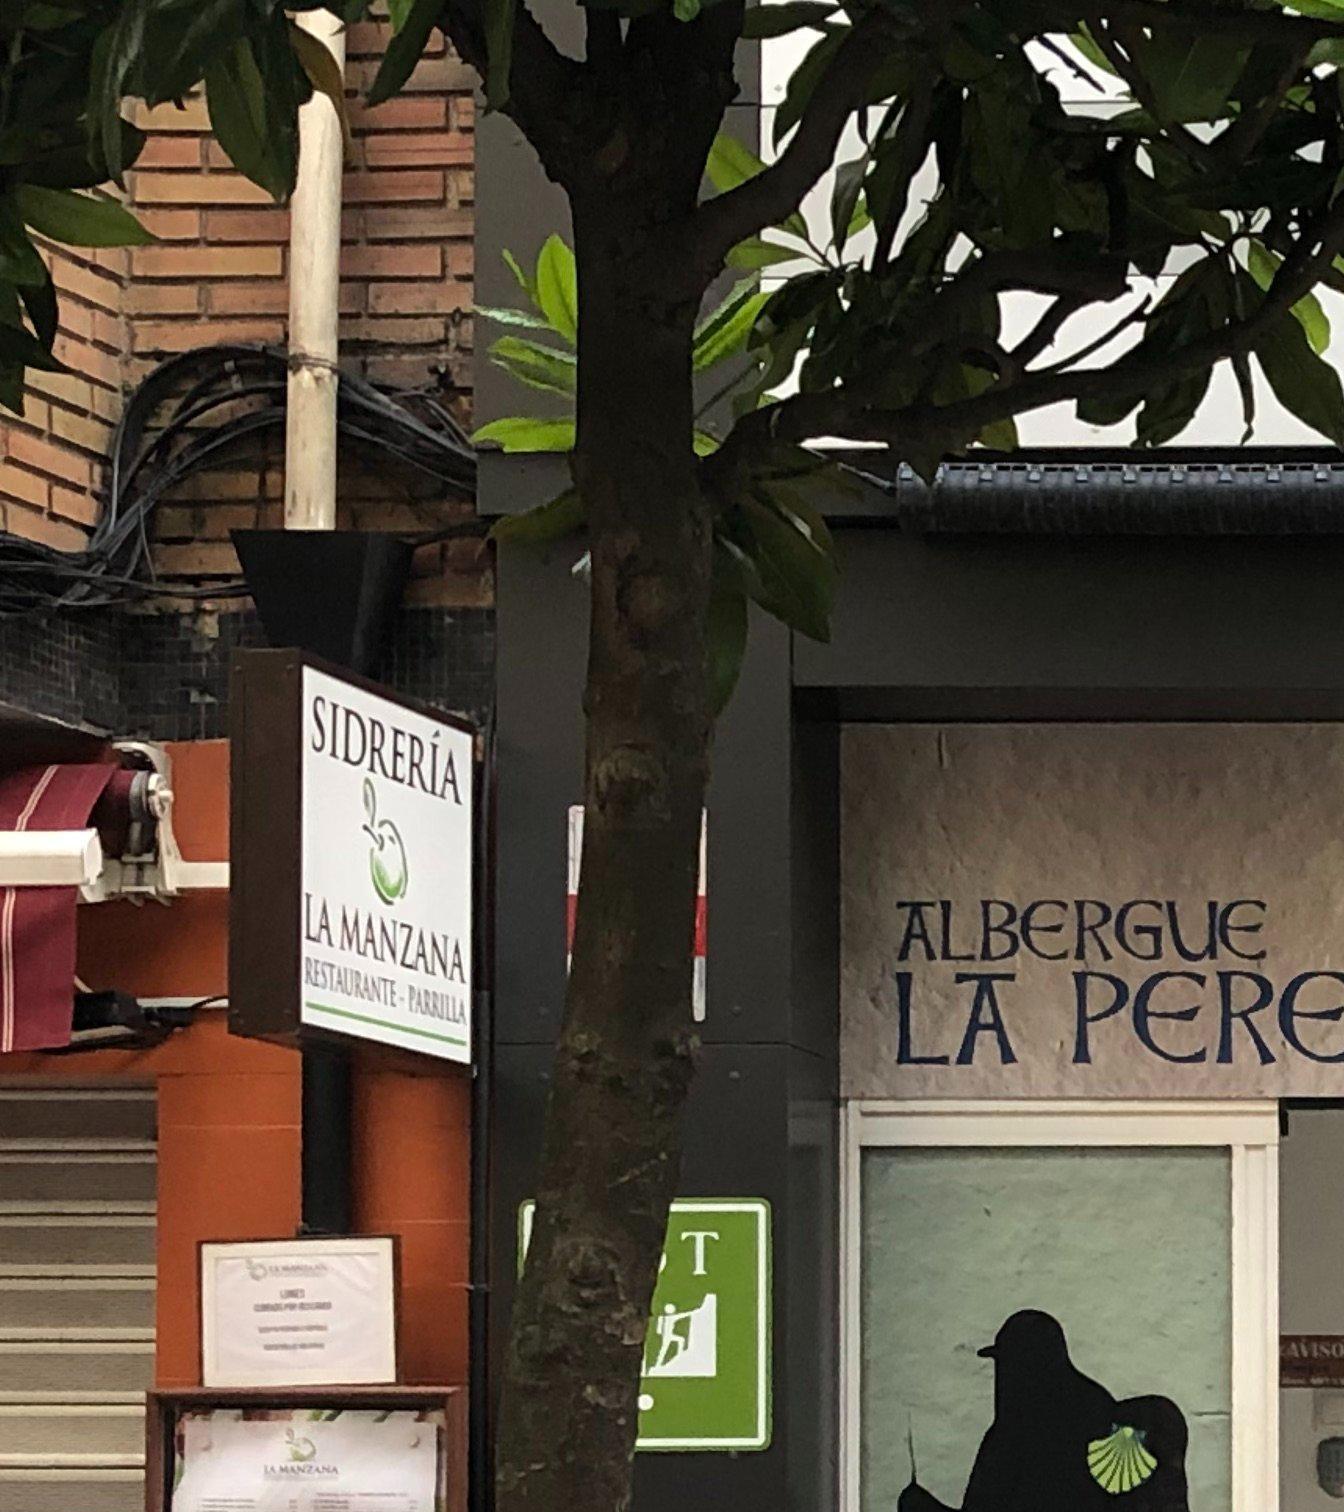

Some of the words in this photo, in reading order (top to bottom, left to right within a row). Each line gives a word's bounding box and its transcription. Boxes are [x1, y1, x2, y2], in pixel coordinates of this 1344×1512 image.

[310, 695, 463, 805] SIDRERÍA
[304, 891, 334, 948] LA
[339, 904, 467, 984] MANZANA
[895, 900, 1268, 962] ALBERGUE
[304, 955, 397, 1008] RESTAURANTE
[408, 983, 467, 1026] PARRILLA
[895, 971, 1017, 1066] LA
[279, 1464, 339, 1476] MANZANA
